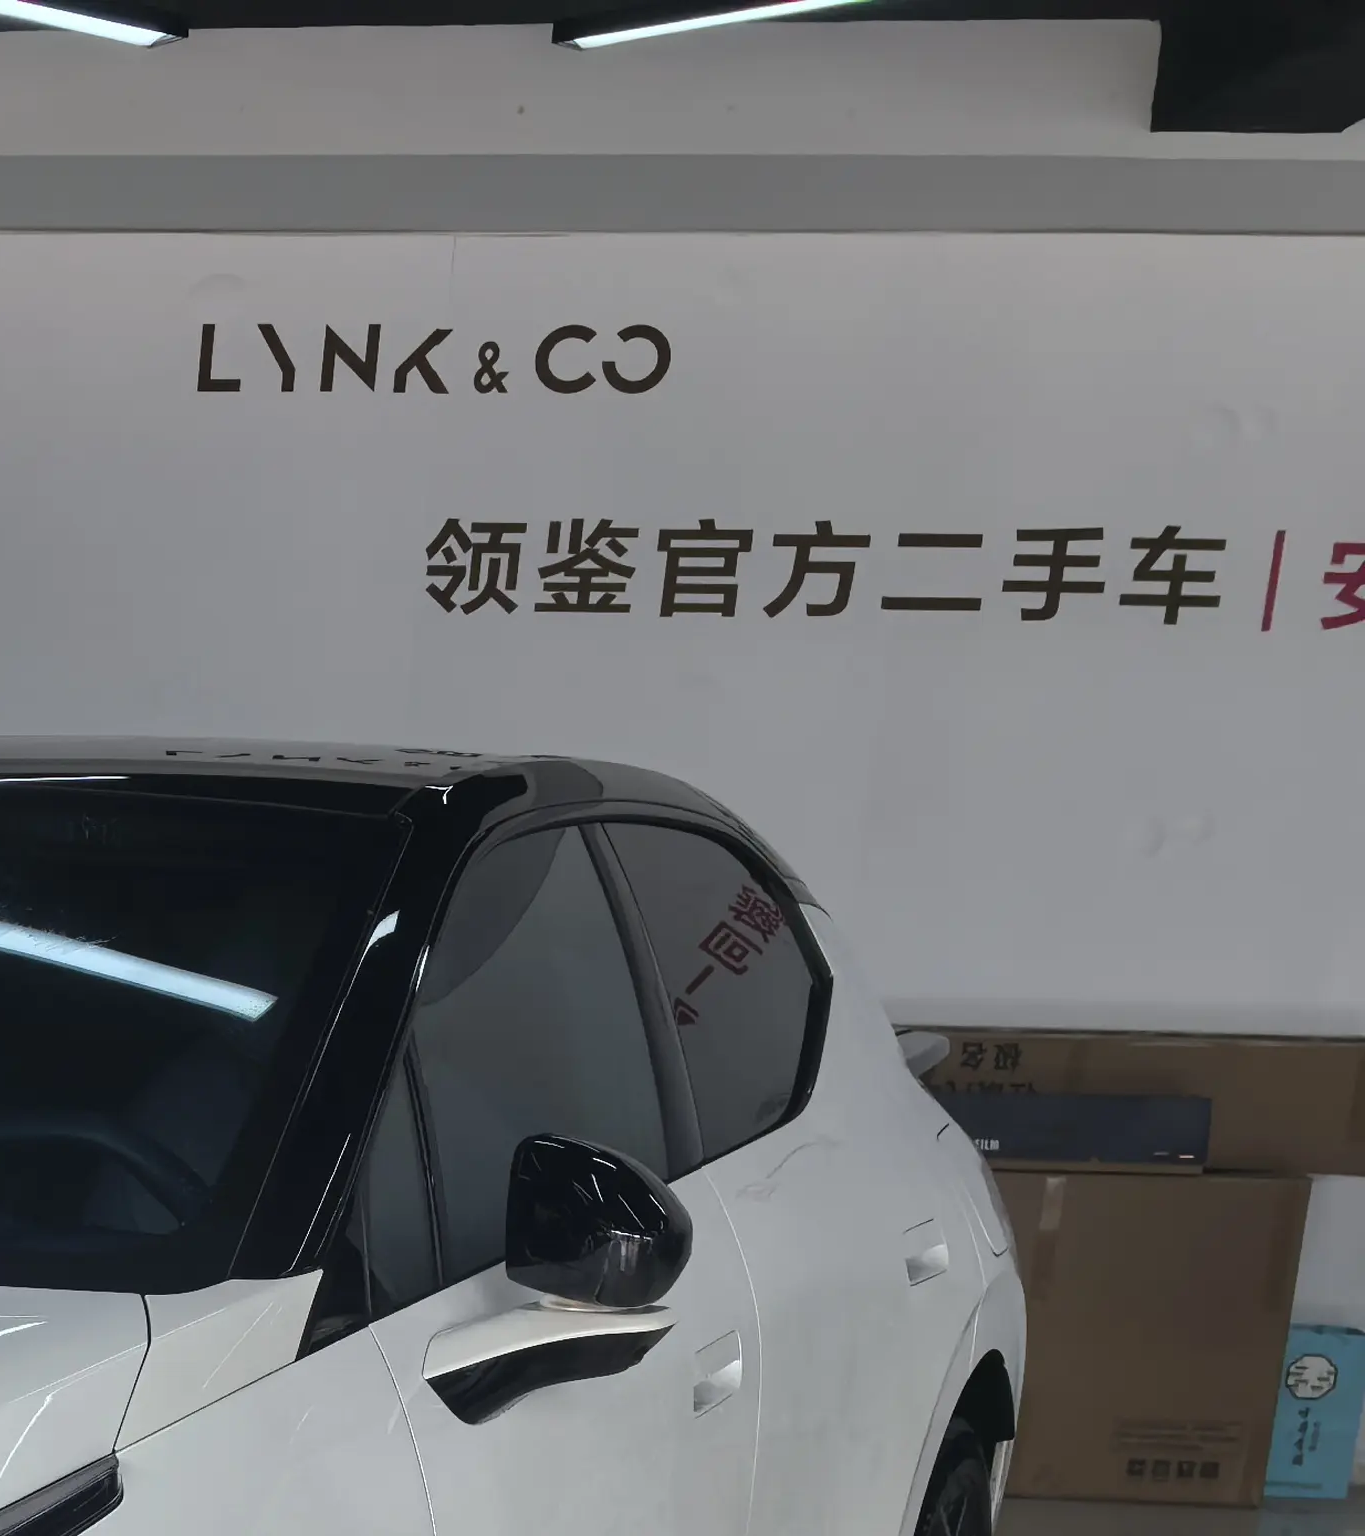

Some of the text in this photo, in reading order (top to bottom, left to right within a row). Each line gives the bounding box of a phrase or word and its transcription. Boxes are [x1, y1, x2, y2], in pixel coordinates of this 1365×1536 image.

[425, 517, 1227, 626] 领鉴官方二手车
